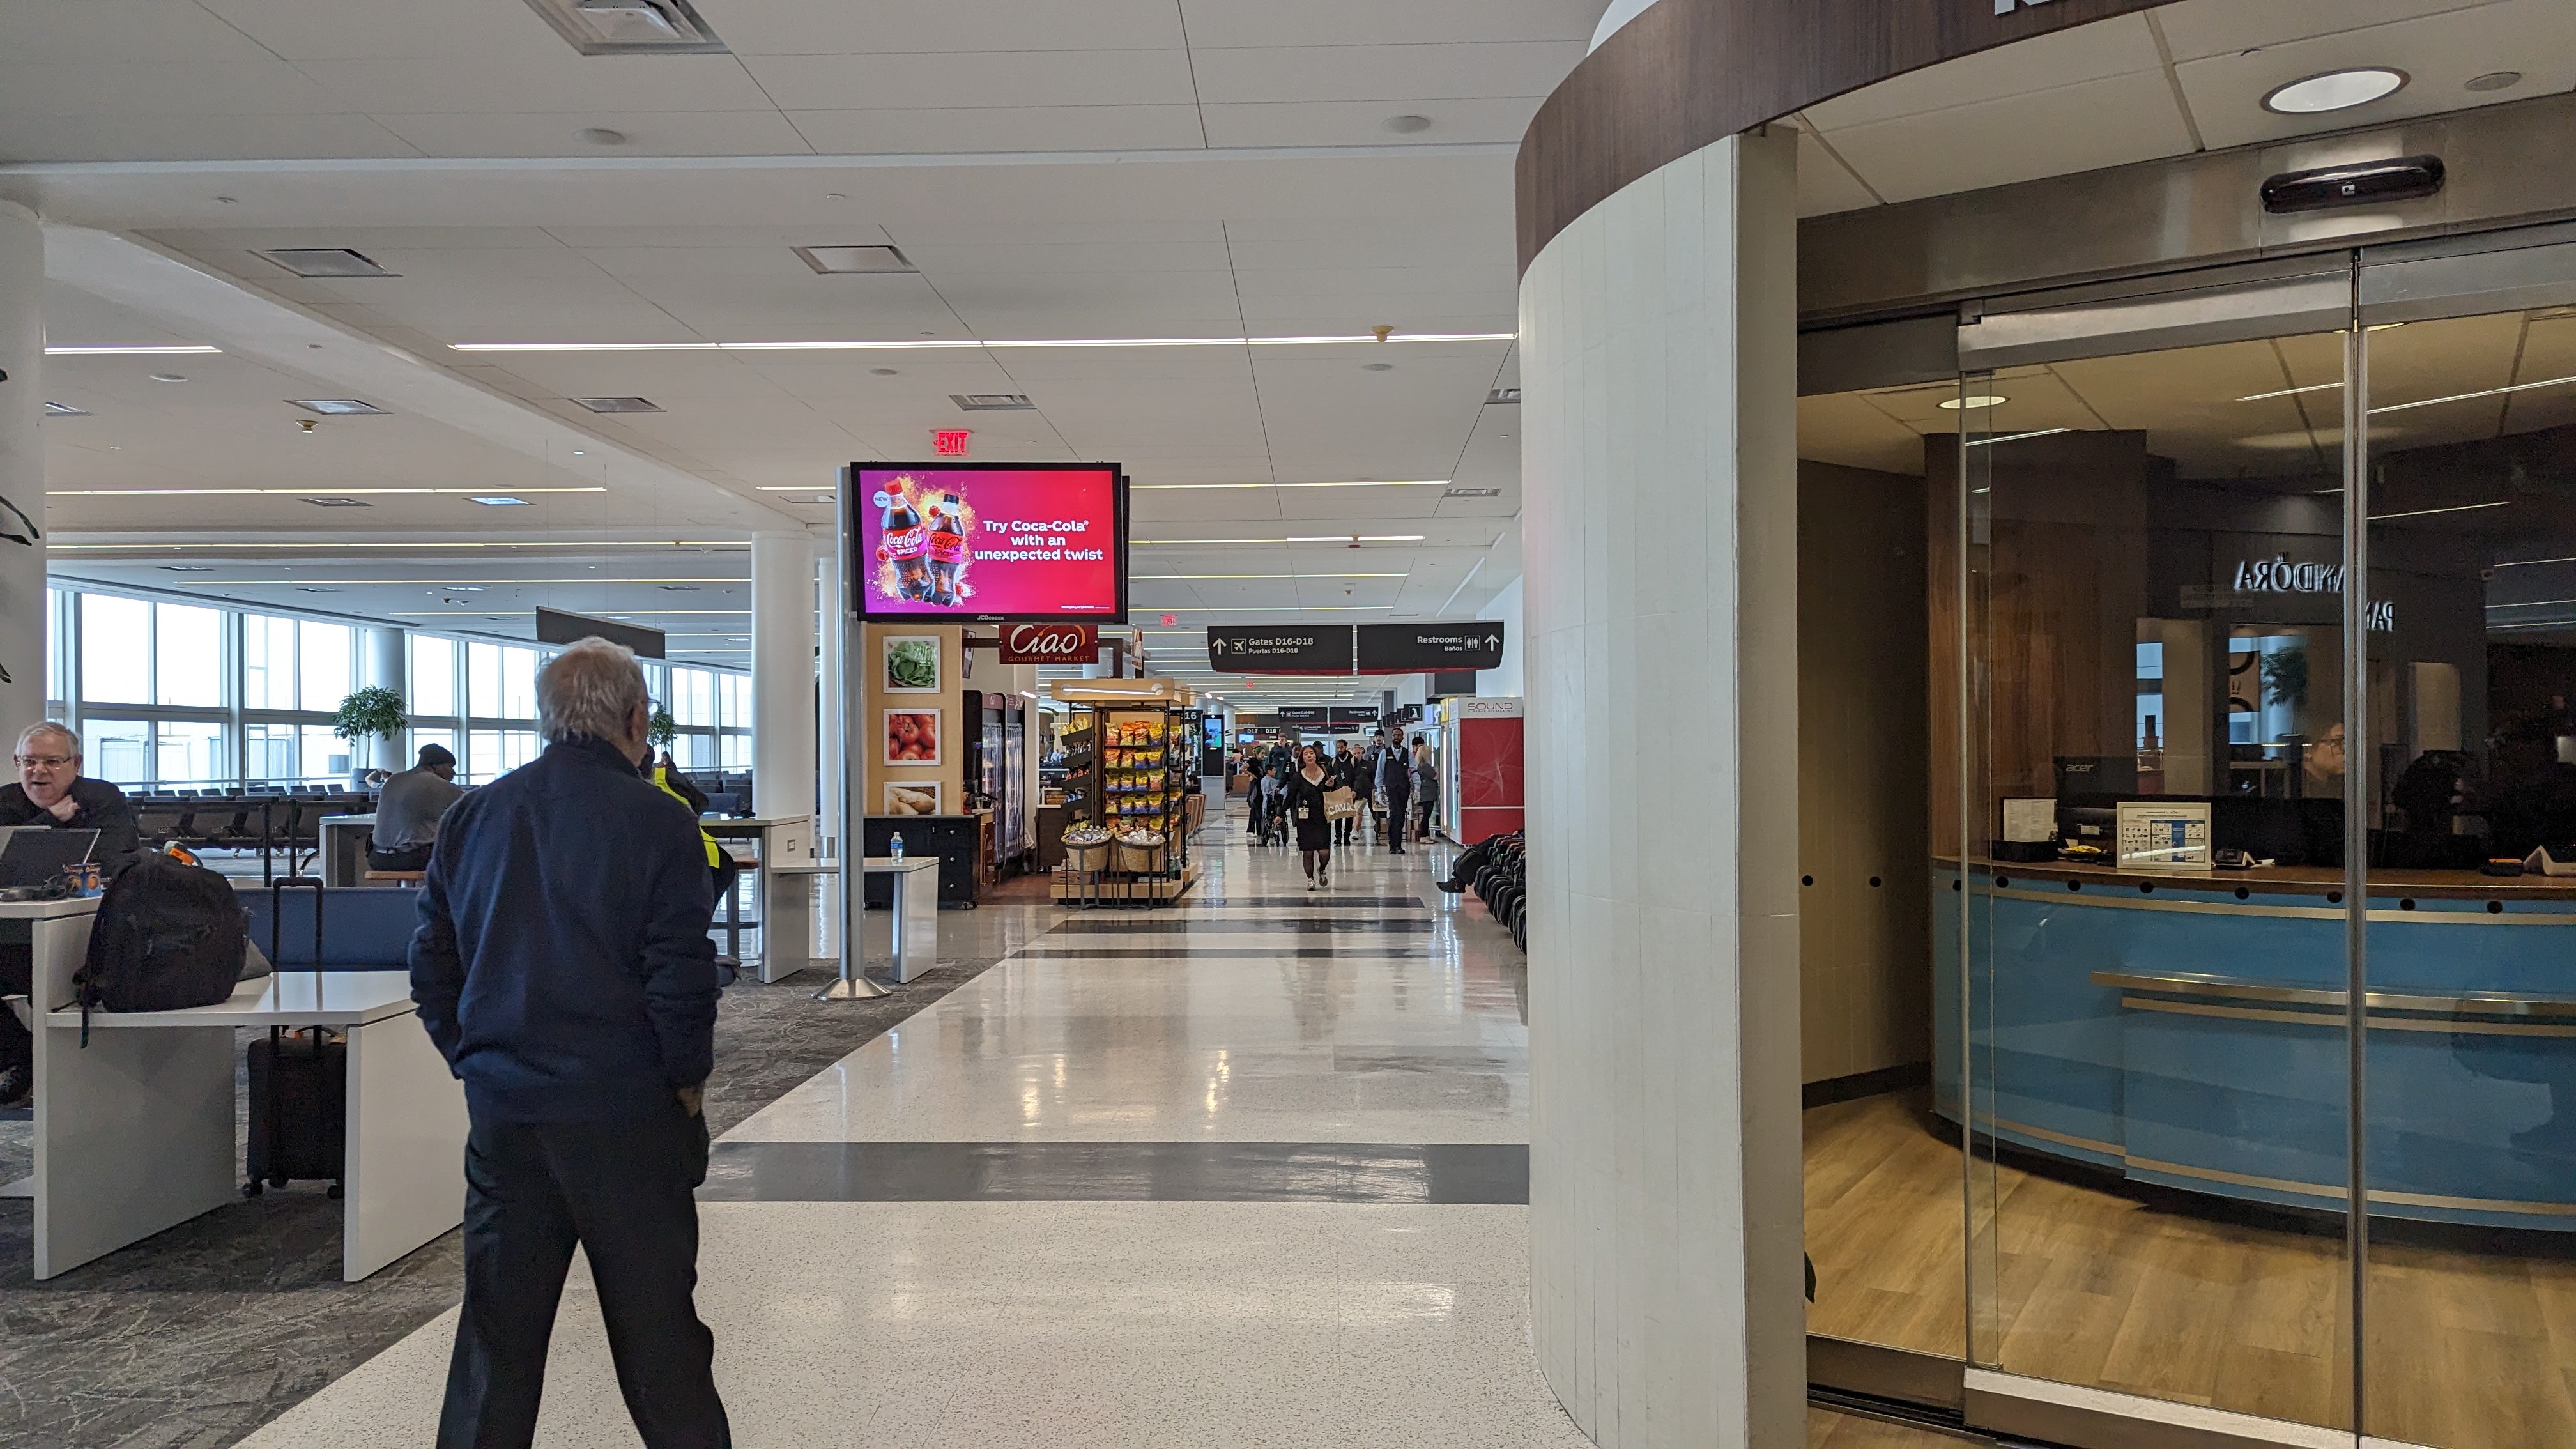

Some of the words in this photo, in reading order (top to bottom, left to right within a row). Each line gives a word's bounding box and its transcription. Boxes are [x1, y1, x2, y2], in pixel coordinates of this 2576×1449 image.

[937, 433, 967, 453] EXIT
[983, 520, 1008, 534] Try
[1010, 534, 1045, 546] with
[1047, 536, 1066, 546] an
[896, 546, 918, 555] SPICED
[974, 549, 1061, 562] unexpected
[1064, 548, 1103, 560] twist
[1009, 624, 1078, 654] Ciao
[1248, 638, 1273, 646] Gates
[1275, 638, 1314, 646] D16-D18
[1417, 636, 1463, 644] Restrooms
[1468, 702, 1513, 710] SOUND
[1328, 802, 1354, 815] CAVA
